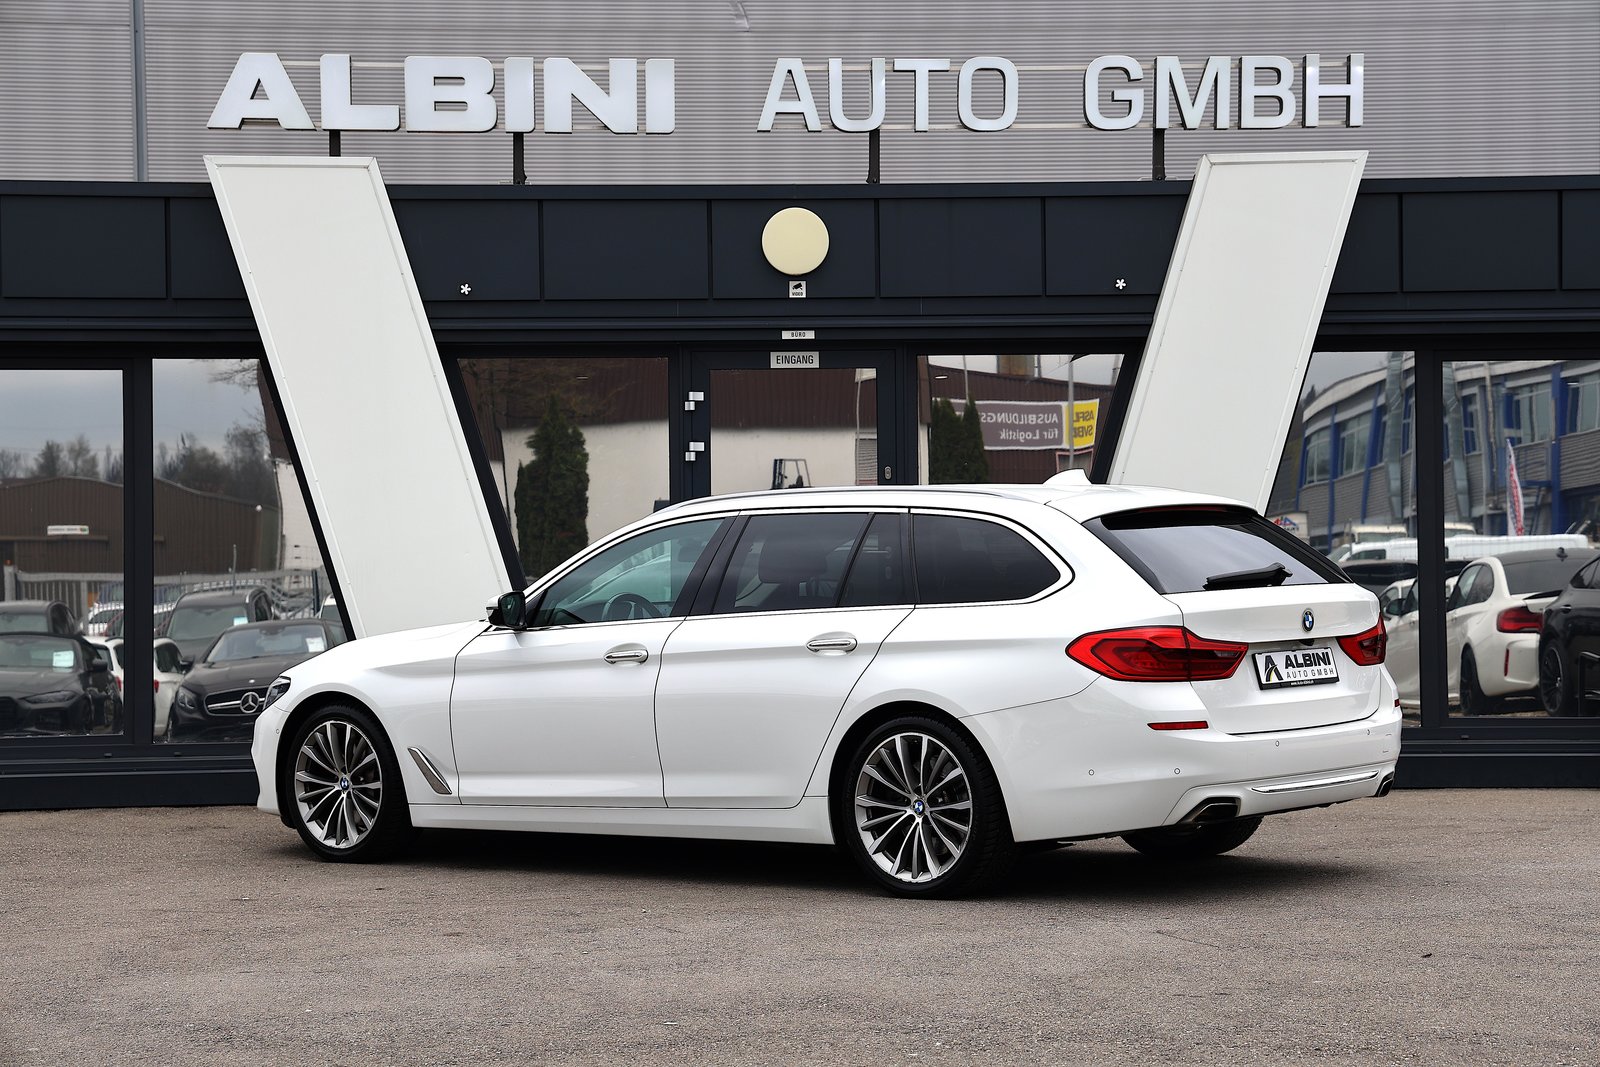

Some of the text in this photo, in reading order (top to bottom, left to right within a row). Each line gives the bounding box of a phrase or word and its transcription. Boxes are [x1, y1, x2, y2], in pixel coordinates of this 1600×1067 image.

[206, 52, 1365, 135] ALBINI AUTO GMBH
[776, 354, 814, 365] EINGANG
[1284, 652, 1332, 669] ALBINI
[1286, 668, 1334, 679] AUTO GMBH
